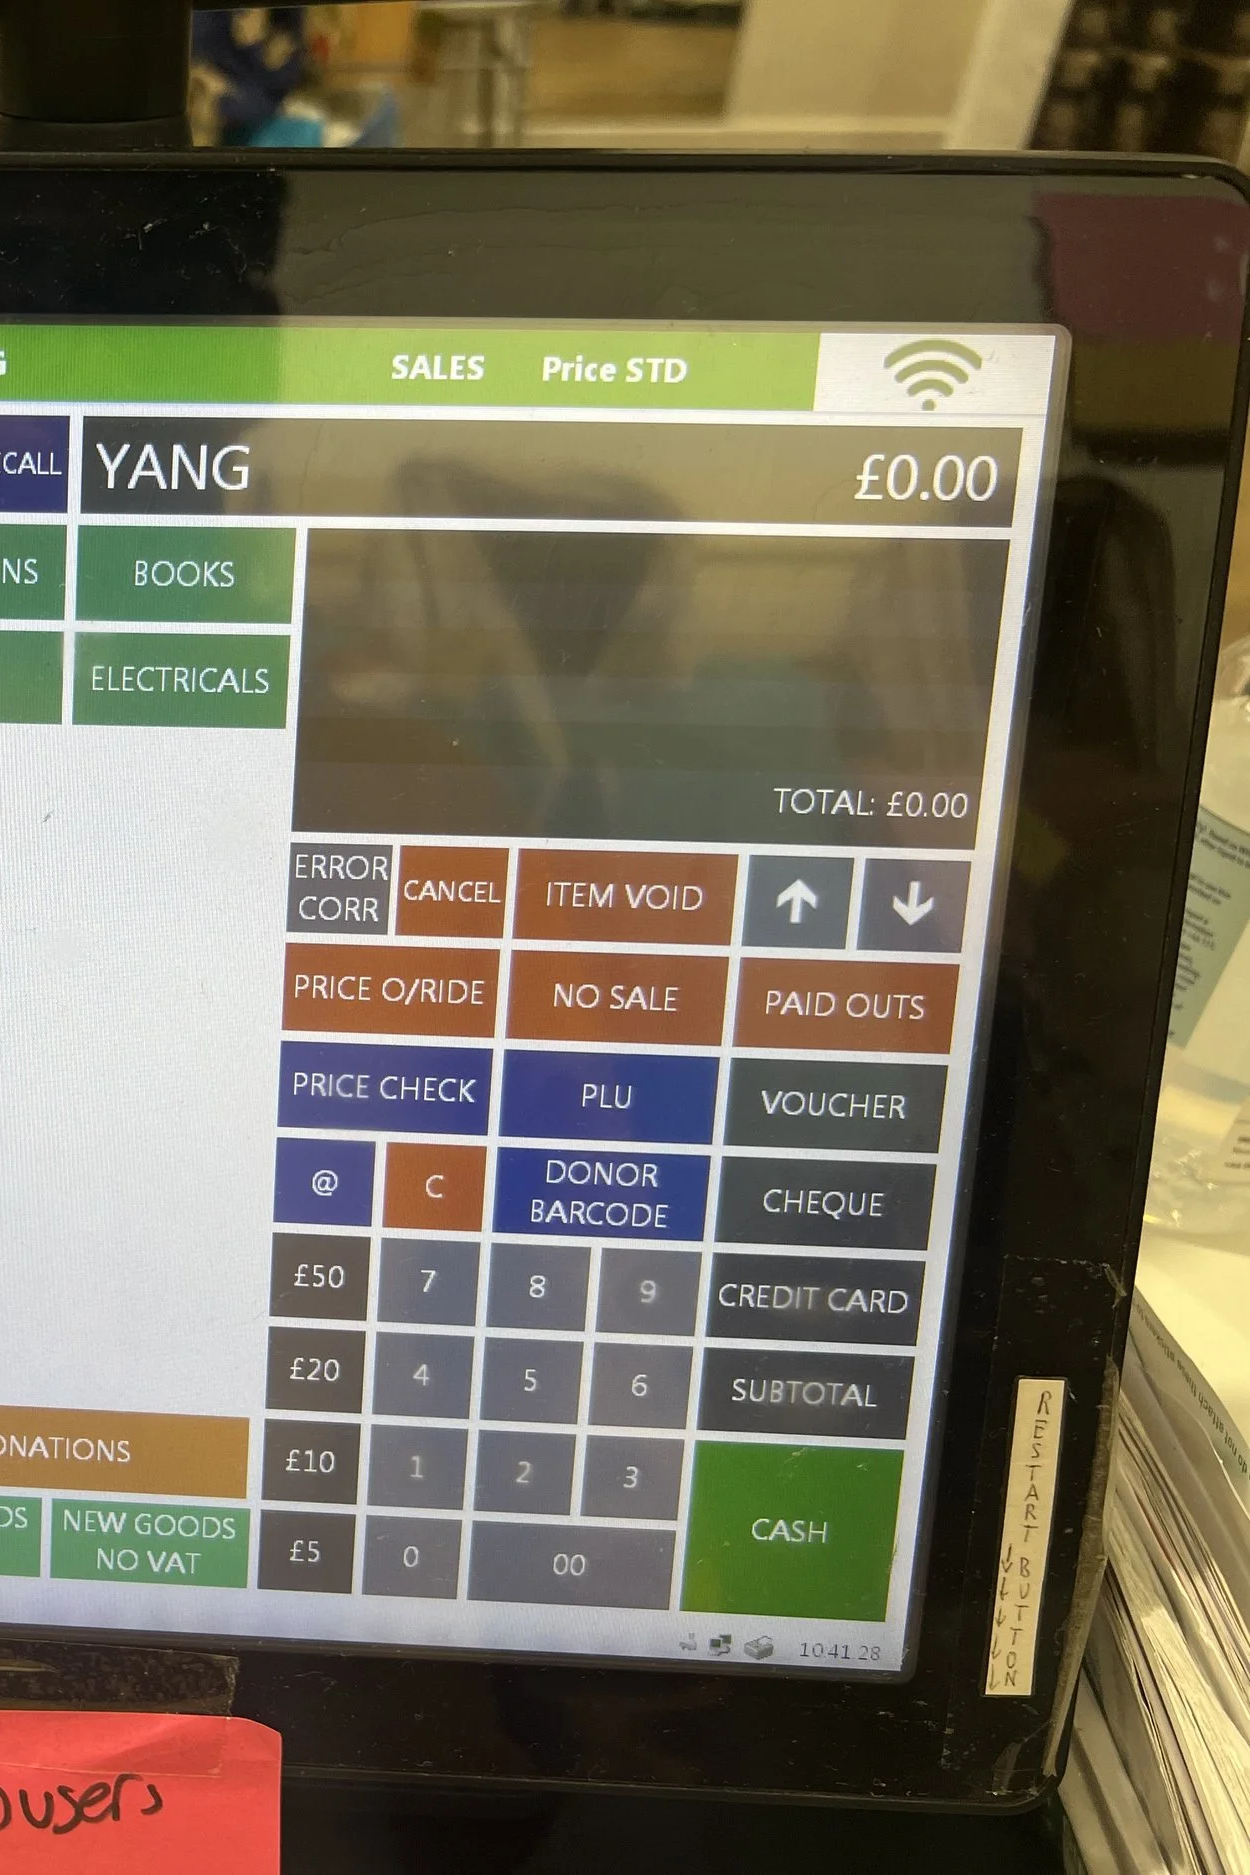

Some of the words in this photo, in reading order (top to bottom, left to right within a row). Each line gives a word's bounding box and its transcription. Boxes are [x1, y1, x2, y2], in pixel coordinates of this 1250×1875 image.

[391, 355, 484, 381] SALES
[542, 357, 617, 383] Price
[625, 358, 688, 384] STD
[96, 443, 250, 491] YANG
[854, 455, 997, 501] £0.00
[134, 561, 235, 588] BOOKS
[91, 667, 269, 695] ELECTRICALS
[773, 788, 874, 818] TOTAL:
[887, 791, 968, 819] £0.00
[295, 855, 388, 882] ERROR
[403, 880, 501, 904] CANCEL
[546, 882, 613, 909] ITEM
[625, 885, 703, 911] VOID
[299, 897, 378, 923] CORR
[294, 976, 371, 1002] PRICE
[382, 977, 485, 1006] O/RIDE
[553, 983, 599, 1009] NO
[610, 985, 678, 1012] SALE
[765, 990, 835, 1018] PAID
[846, 993, 925, 1020] OUTS
[293, 1072, 370, 1099] PRICE
[379, 1075, 476, 1103] CHECK
[582, 1083, 632, 1109] PLU
[762, 1090, 906, 1120] VOUCHER
[312, 1169, 338, 1196] @
[426, 1174, 443, 1200] C
[546, 1160, 659, 1188] DONOR
[531, 1201, 669, 1229] BARCODE
[763, 1189, 884, 1219] CHEQUE
[294, 1264, 345, 1289] £50
[421, 1269, 437, 1293] 7
[530, 1274, 546, 1298] 8
[640, 1280, 656, 1303] 9
[719, 1283, 818, 1311] CREDIT
[827, 1286, 908, 1313] CARD
[290, 1357, 340, 1382] £20
[412, 1363, 430, 1387] 4
[523, 1368, 538, 1392] 5
[631, 1373, 648, 1398] 6
[732, 1378, 876, 1407] SUBTOTAL
[285, 1449, 335, 1474] £10
[410, 1455, 423, 1479] 1
[516, 1460, 532, 1484] 2
[1024, 1390, 1052, 1543] RESTART
[624, 1466, 639, 1489] 3
[63, 1509, 127, 1534] NEW
[134, 1514, 236, 1540] GOODS
[751, 1517, 827, 1544] CASH
[97, 1549, 138, 1572] NO
[147, 1551, 201, 1575] VAT
[289, 1538, 321, 1563] £5
[403, 1545, 419, 1569] 0
[553, 1553, 585, 1577] 00
[1004, 1556, 1031, 1688] BUTTON
